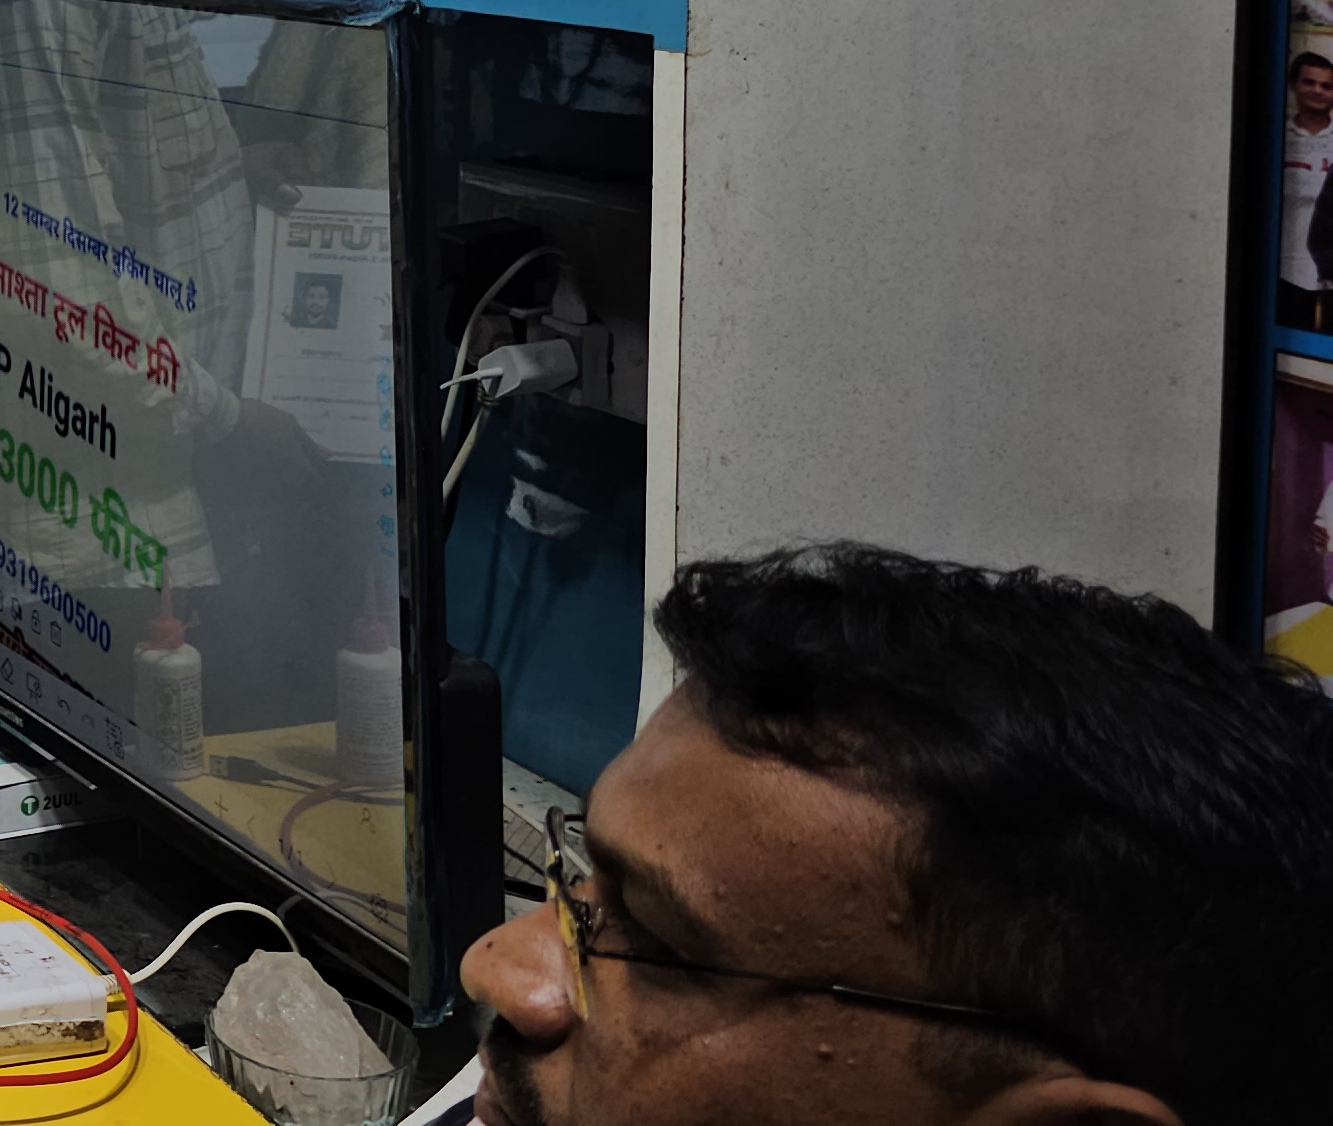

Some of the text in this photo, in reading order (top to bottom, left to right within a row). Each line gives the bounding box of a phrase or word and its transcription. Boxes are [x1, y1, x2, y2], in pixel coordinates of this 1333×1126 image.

[4, 191, 20, 219] 12
[53, 291, 88, 344] टूल
[93, 302, 140, 371] किट
[146, 336, 180, 395] फ्री
[18, 359, 117, 460] Aligarh
[89, 486, 169, 593] फीस
[43, 792, 82, 811] 2UUL
